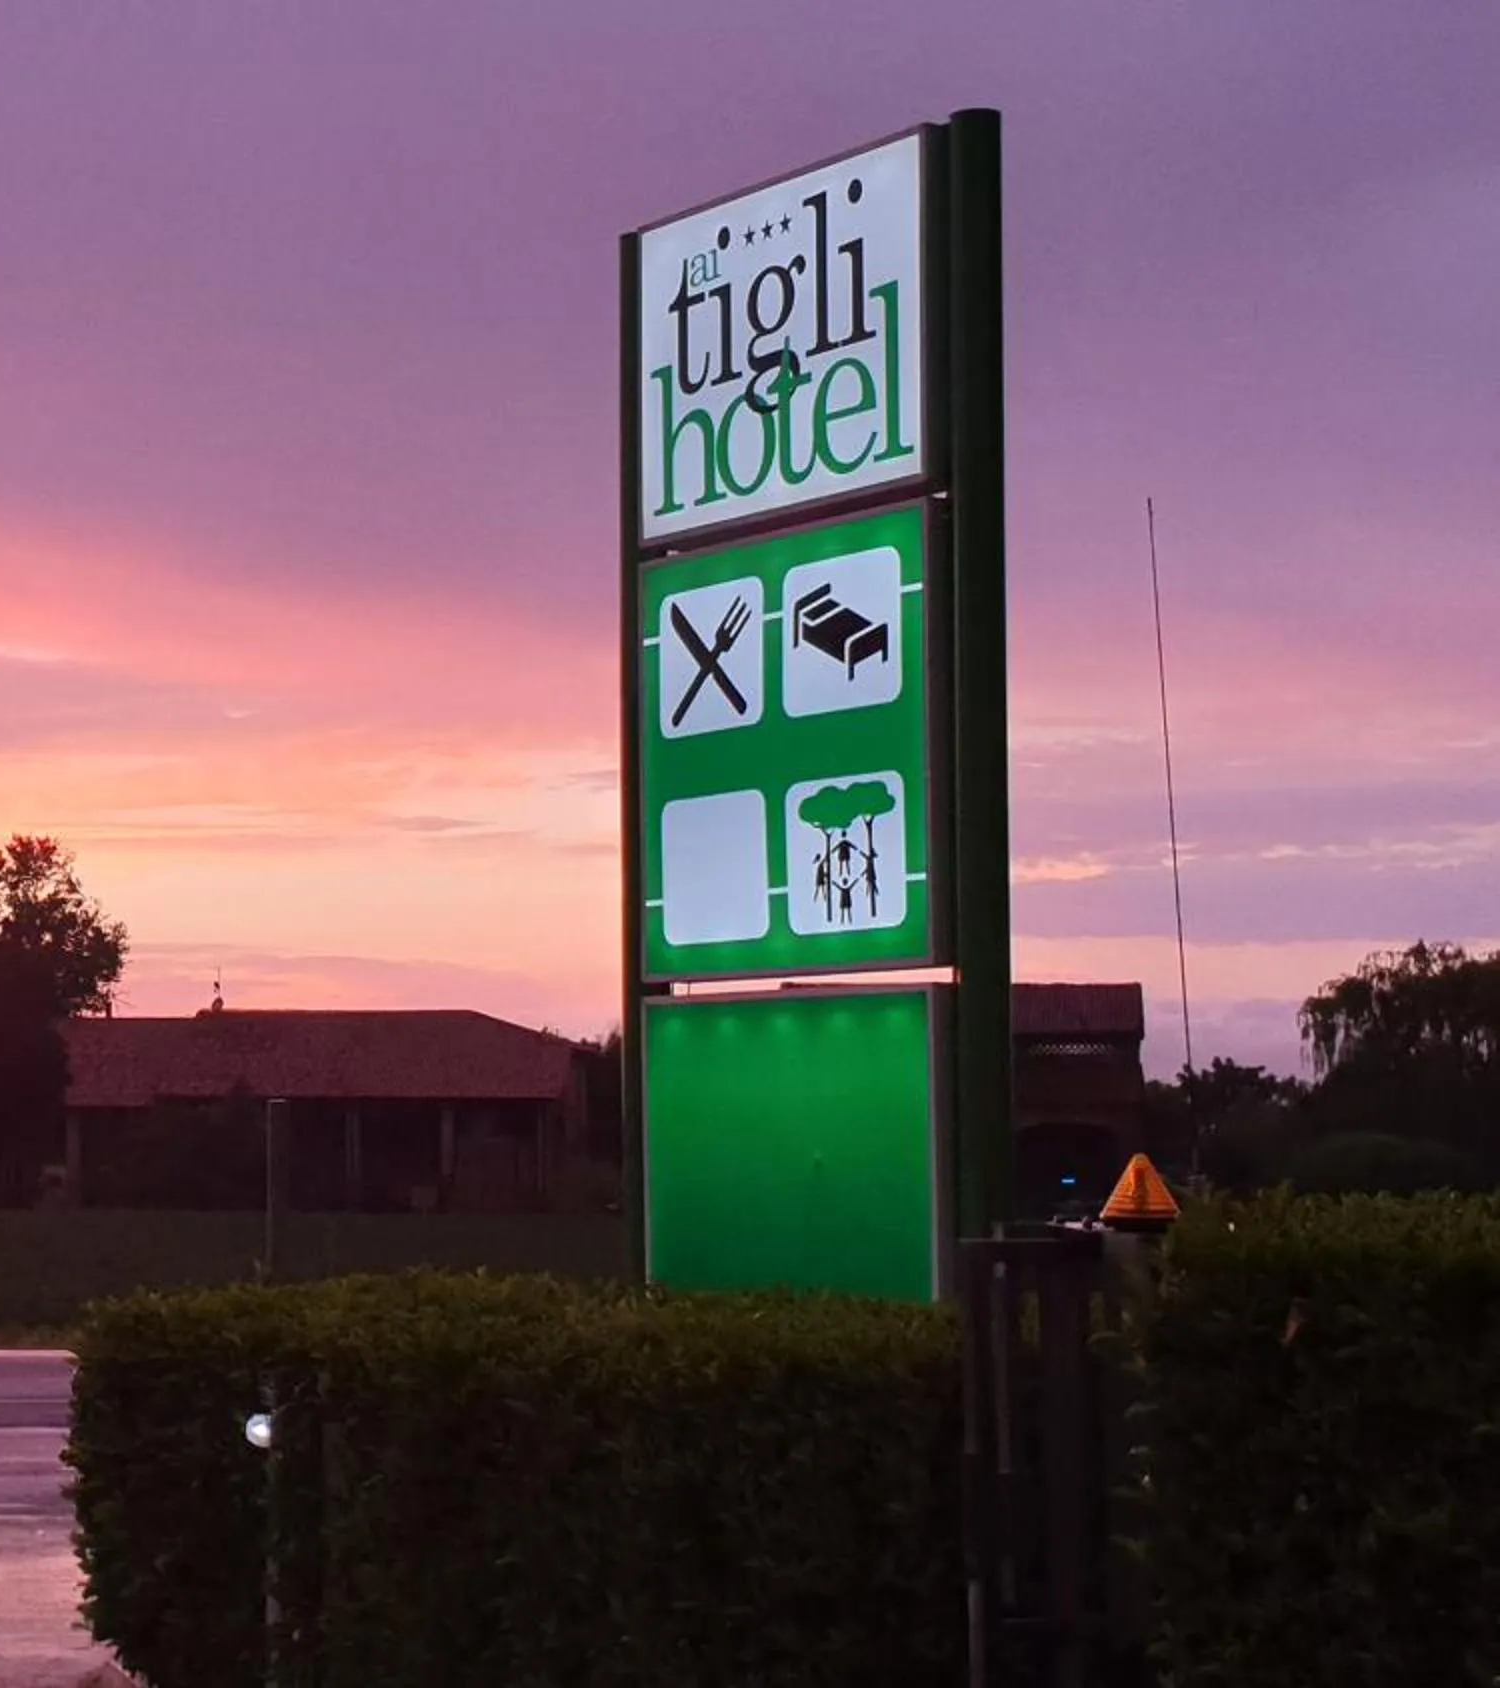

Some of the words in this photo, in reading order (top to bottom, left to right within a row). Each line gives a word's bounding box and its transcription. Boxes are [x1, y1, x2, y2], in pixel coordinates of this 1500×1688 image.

[668, 179, 877, 415] tigli
[688, 245, 722, 289] ai
[651, 279, 915, 517] hotel
